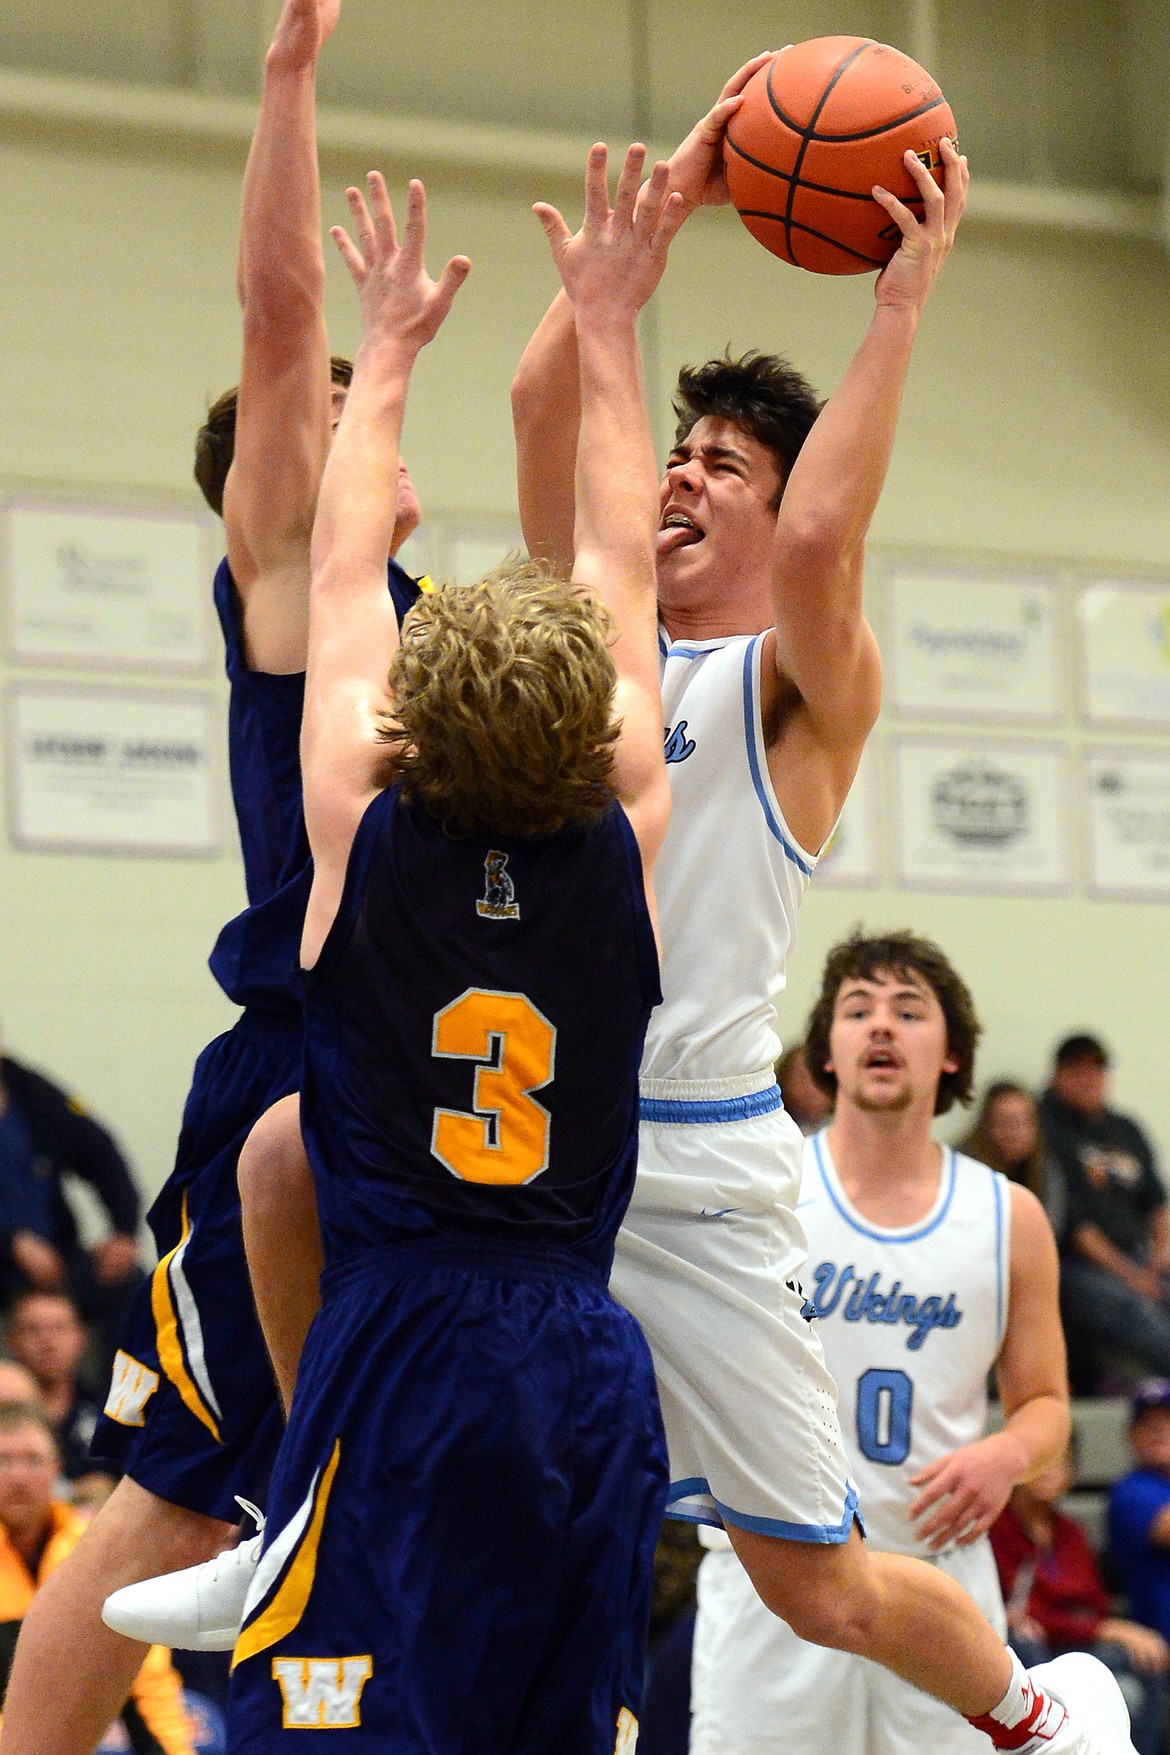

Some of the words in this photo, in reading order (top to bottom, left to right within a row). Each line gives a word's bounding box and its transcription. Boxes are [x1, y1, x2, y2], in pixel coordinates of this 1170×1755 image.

[430, 987, 557, 1186] 3
[813, 1262, 963, 1351] Vikings
[103, 1349, 160, 1428] W
[857, 1368, 914, 1466] 0
[271, 1654, 373, 1730] W
